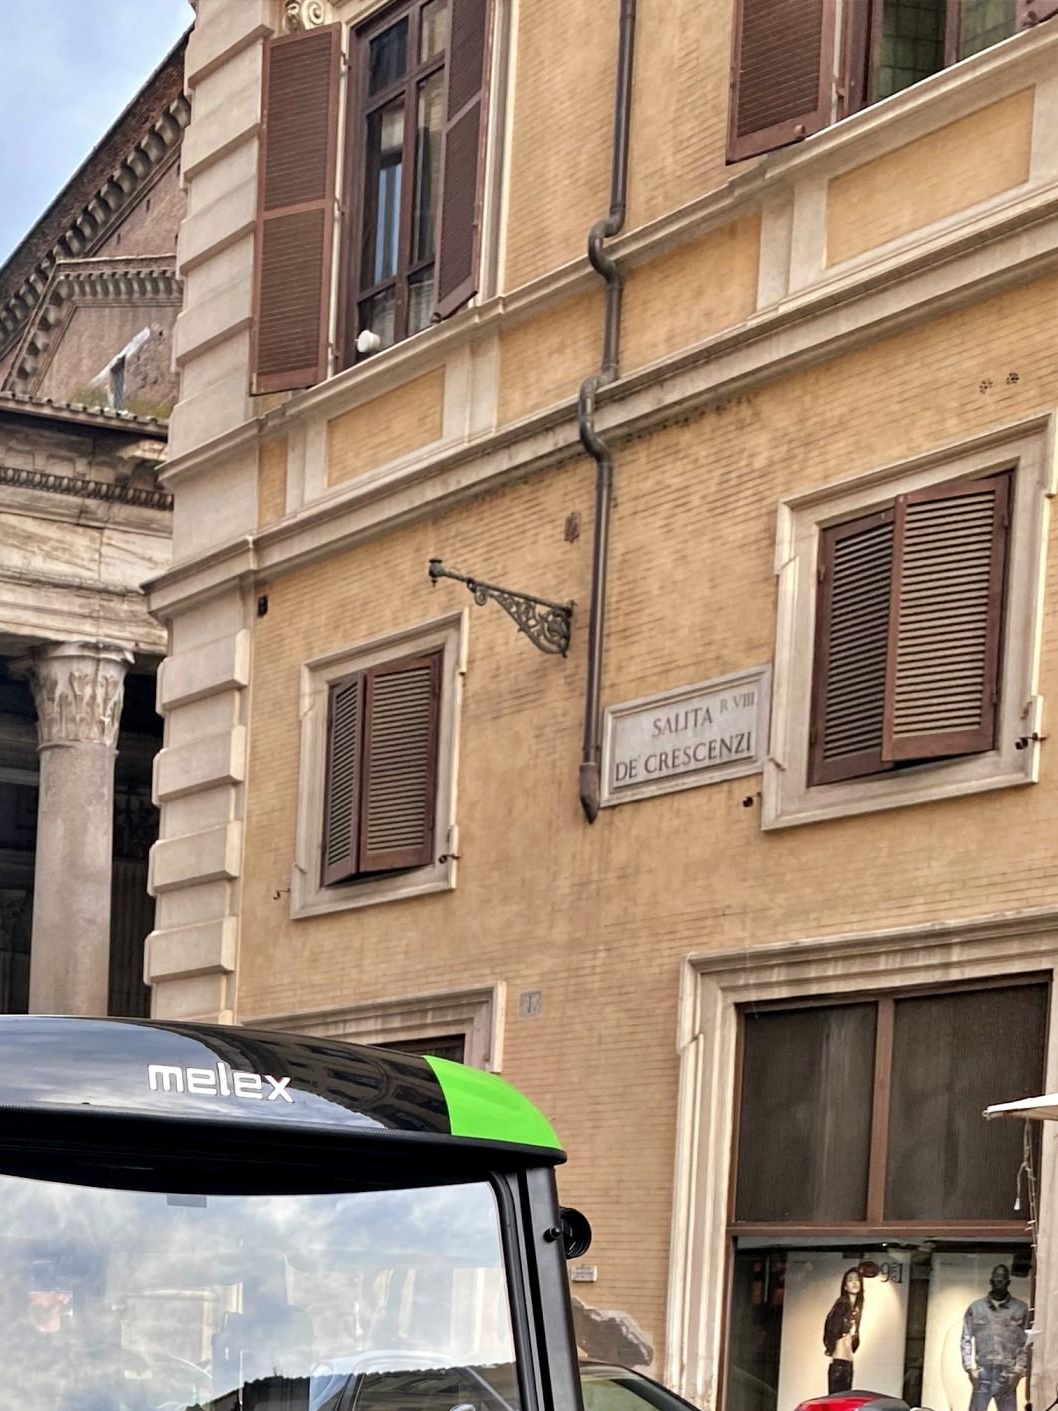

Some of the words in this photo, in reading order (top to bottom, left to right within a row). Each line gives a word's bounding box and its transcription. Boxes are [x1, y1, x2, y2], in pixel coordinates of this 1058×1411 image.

[652, 707, 712, 737] SALITA
[644, 731, 751, 774] CRESCENZI
[147, 1062, 294, 1103] melex
